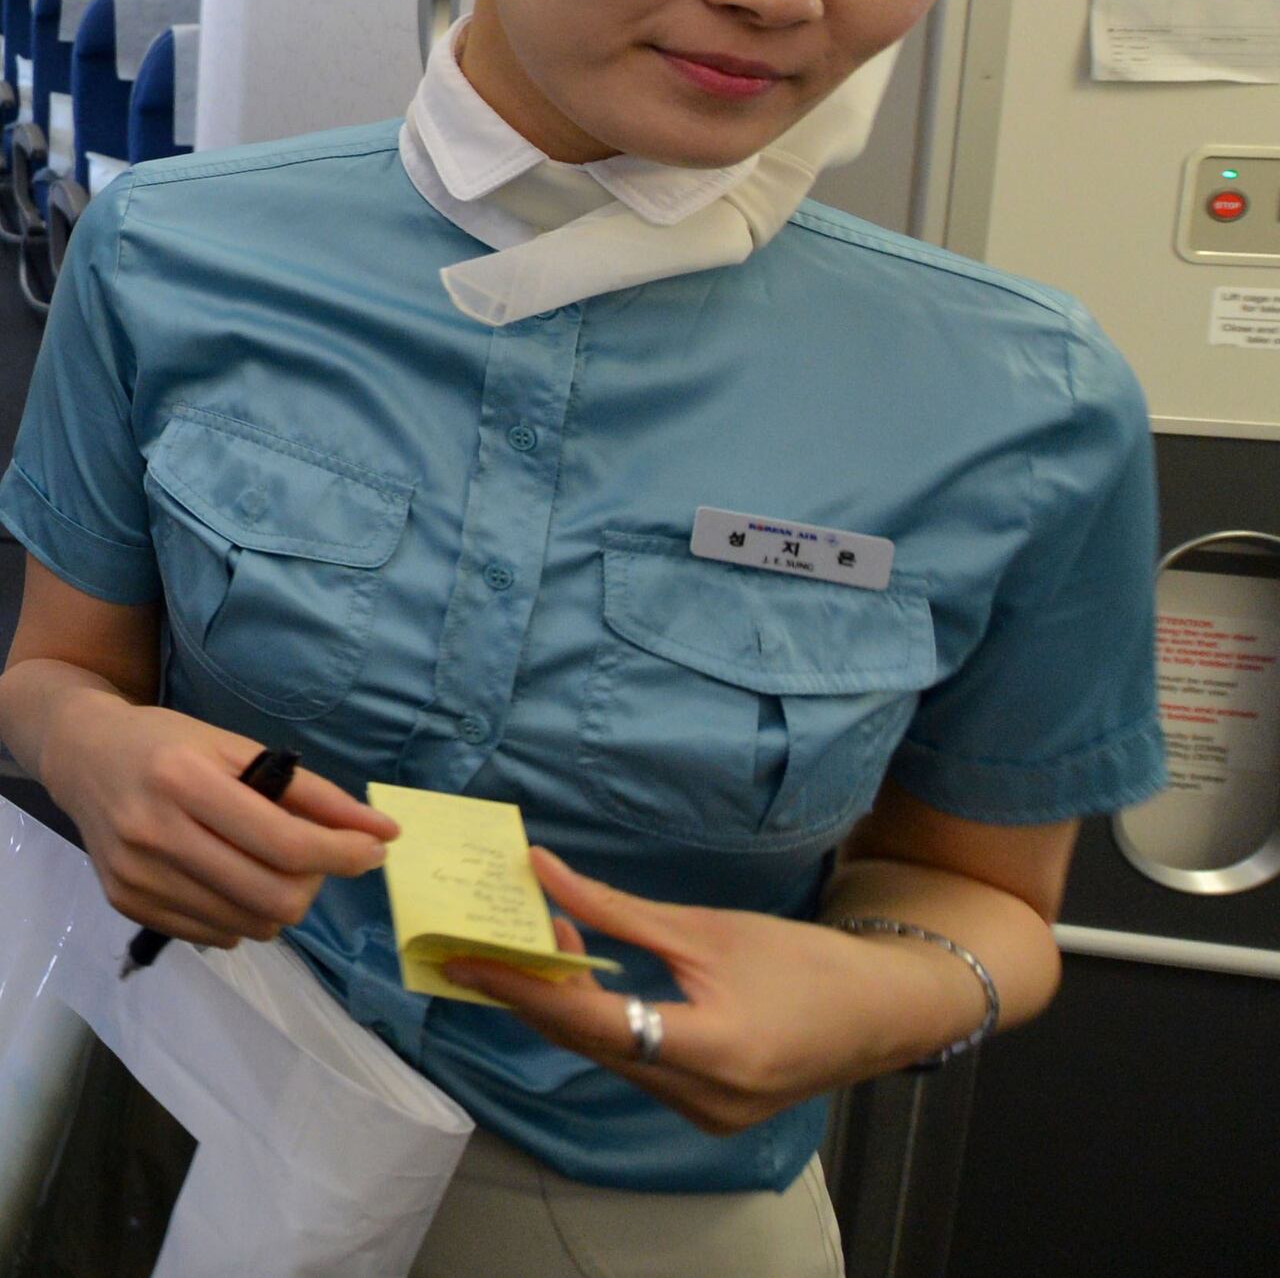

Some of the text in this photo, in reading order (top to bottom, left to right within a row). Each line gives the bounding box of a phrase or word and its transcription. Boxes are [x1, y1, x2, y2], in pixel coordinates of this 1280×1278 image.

[748, 523, 818, 541] KOREAN AIR
[728, 531, 746, 548] 성
[781, 540, 800, 558] 지
